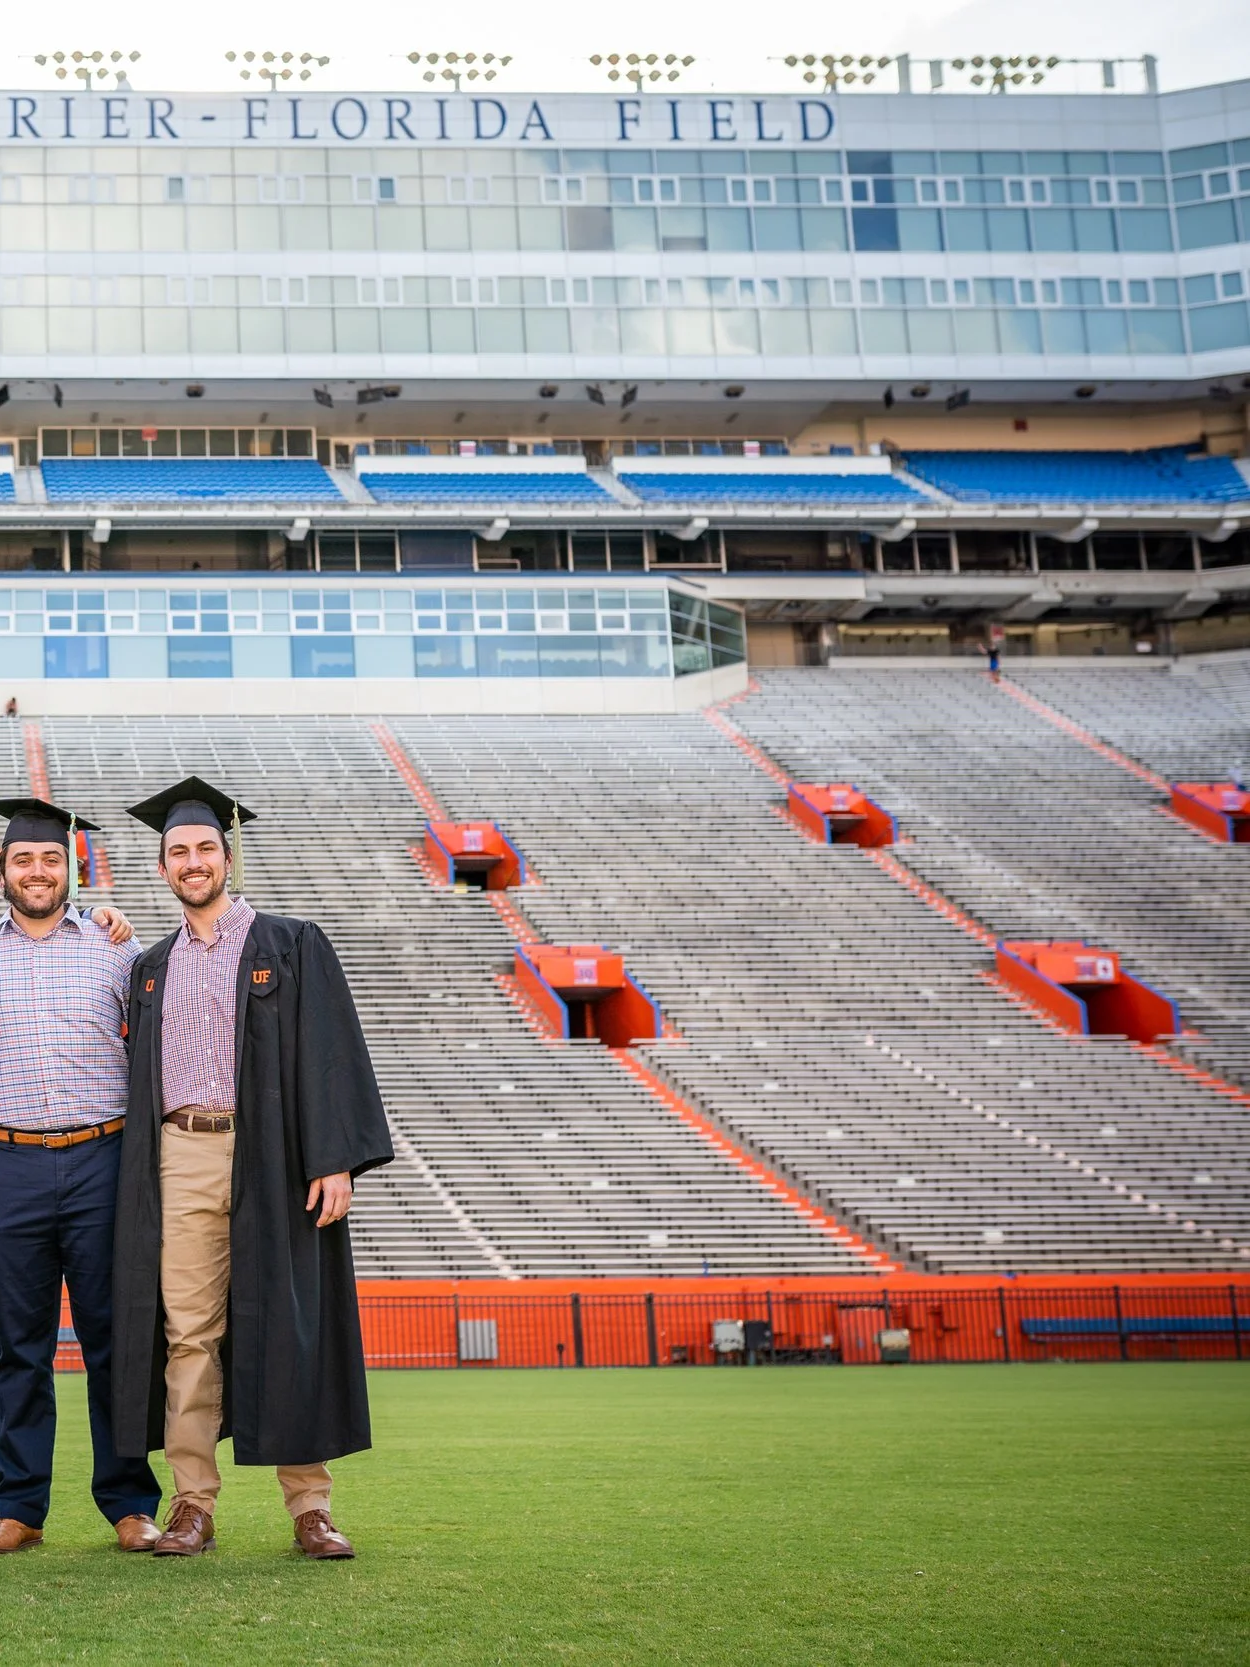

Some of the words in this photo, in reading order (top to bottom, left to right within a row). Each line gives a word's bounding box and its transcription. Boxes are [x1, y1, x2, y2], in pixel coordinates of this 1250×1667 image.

[616, 98, 837, 142] FIELD
[252, 969, 271, 984] UF
[145, 979, 155, 992] U
